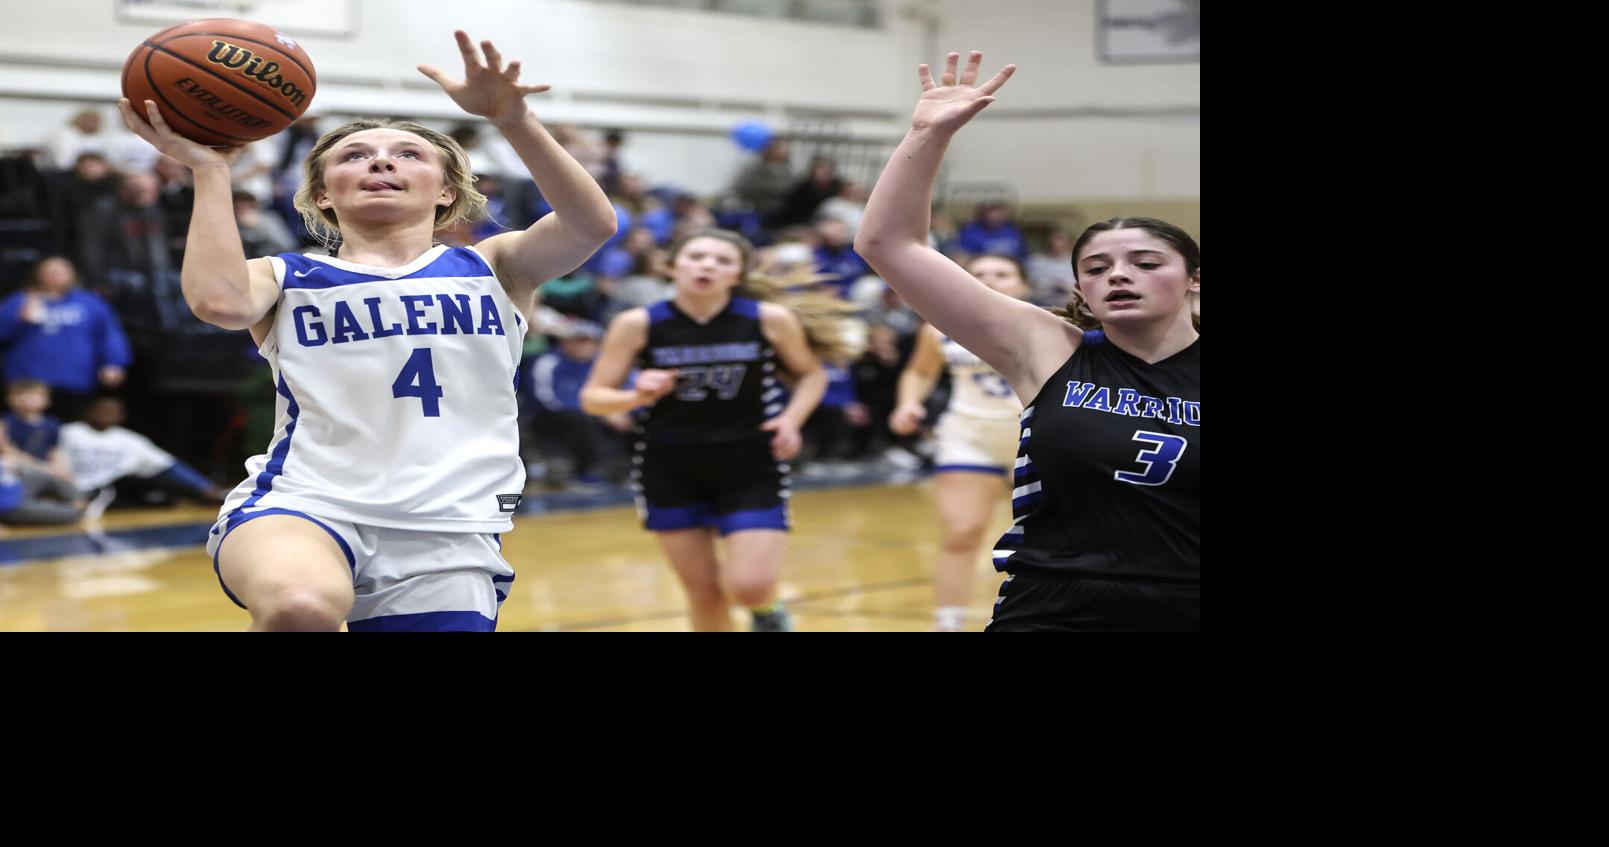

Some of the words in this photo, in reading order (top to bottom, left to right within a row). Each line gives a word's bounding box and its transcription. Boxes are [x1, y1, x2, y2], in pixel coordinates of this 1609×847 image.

[176, 77, 273, 129] EVOLUTION
[207, 39, 306, 109] Wilson
[292, 293, 505, 347] GALENA
[391, 347, 443, 418] 4
[1114, 429, 1188, 487] 3
